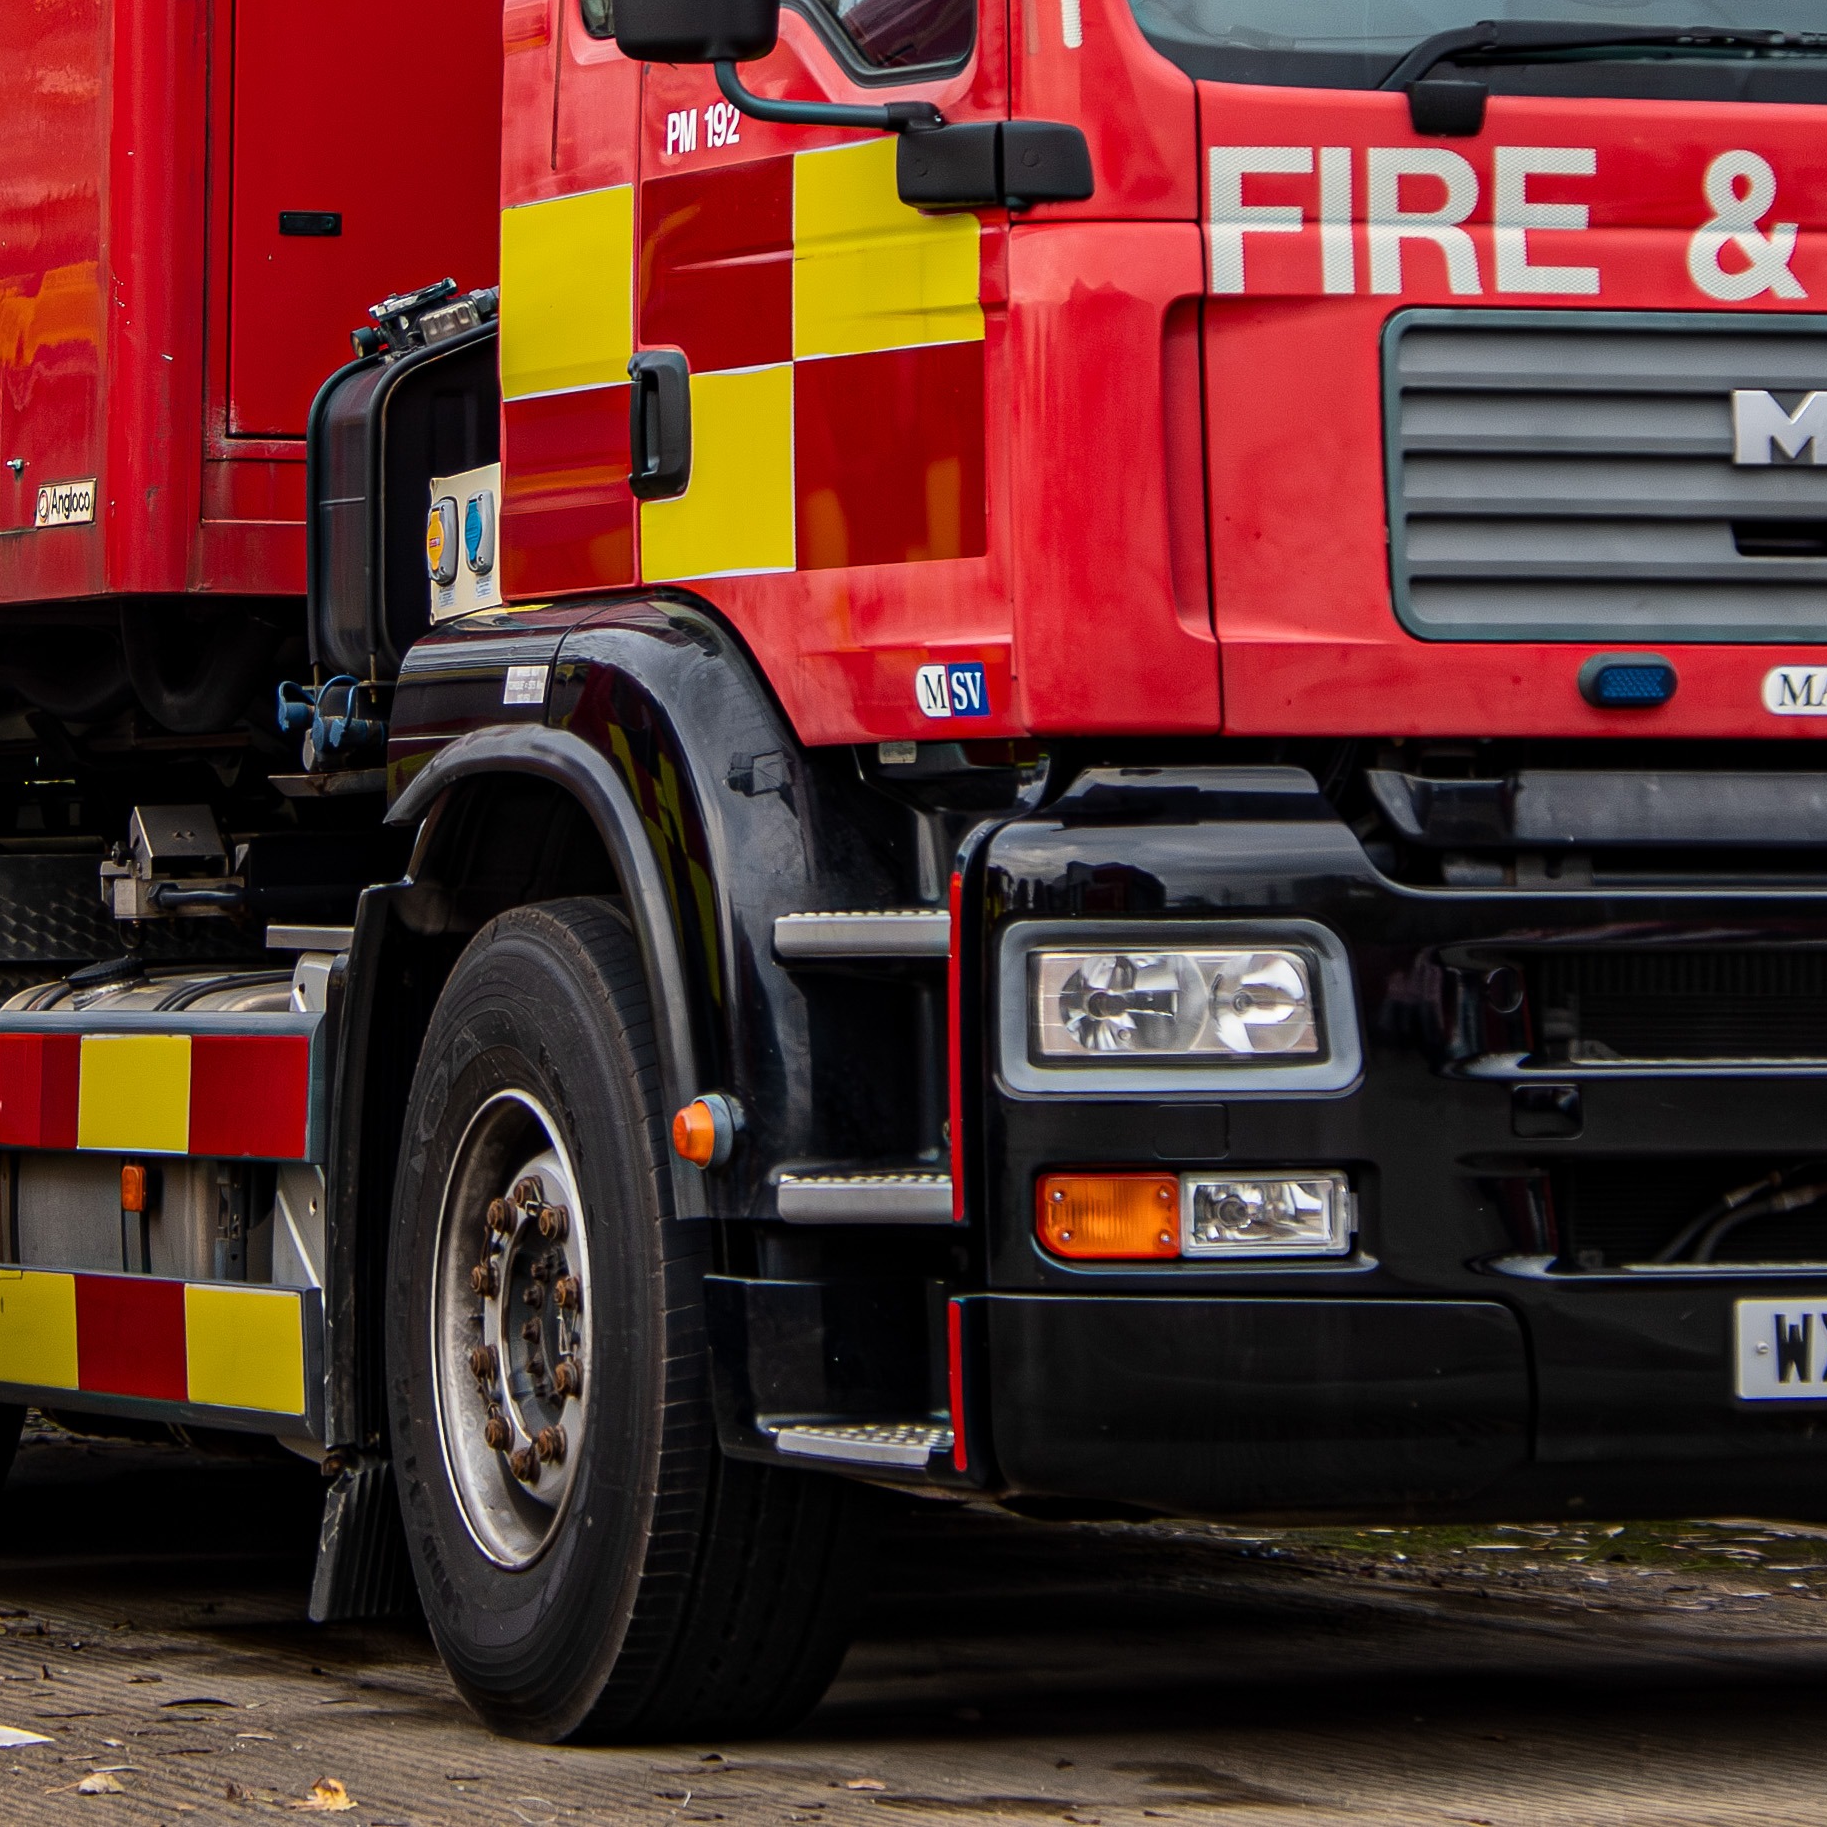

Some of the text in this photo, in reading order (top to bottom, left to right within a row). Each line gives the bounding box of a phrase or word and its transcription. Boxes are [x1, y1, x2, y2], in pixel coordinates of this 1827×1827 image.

[666, 102, 741, 156] PM 192
[1209, 145, 1601, 296] FIRE
[1687, 149, 1809, 301] &
[51, 486, 90, 520] Angloco
[923, 668, 983, 711] M SV
